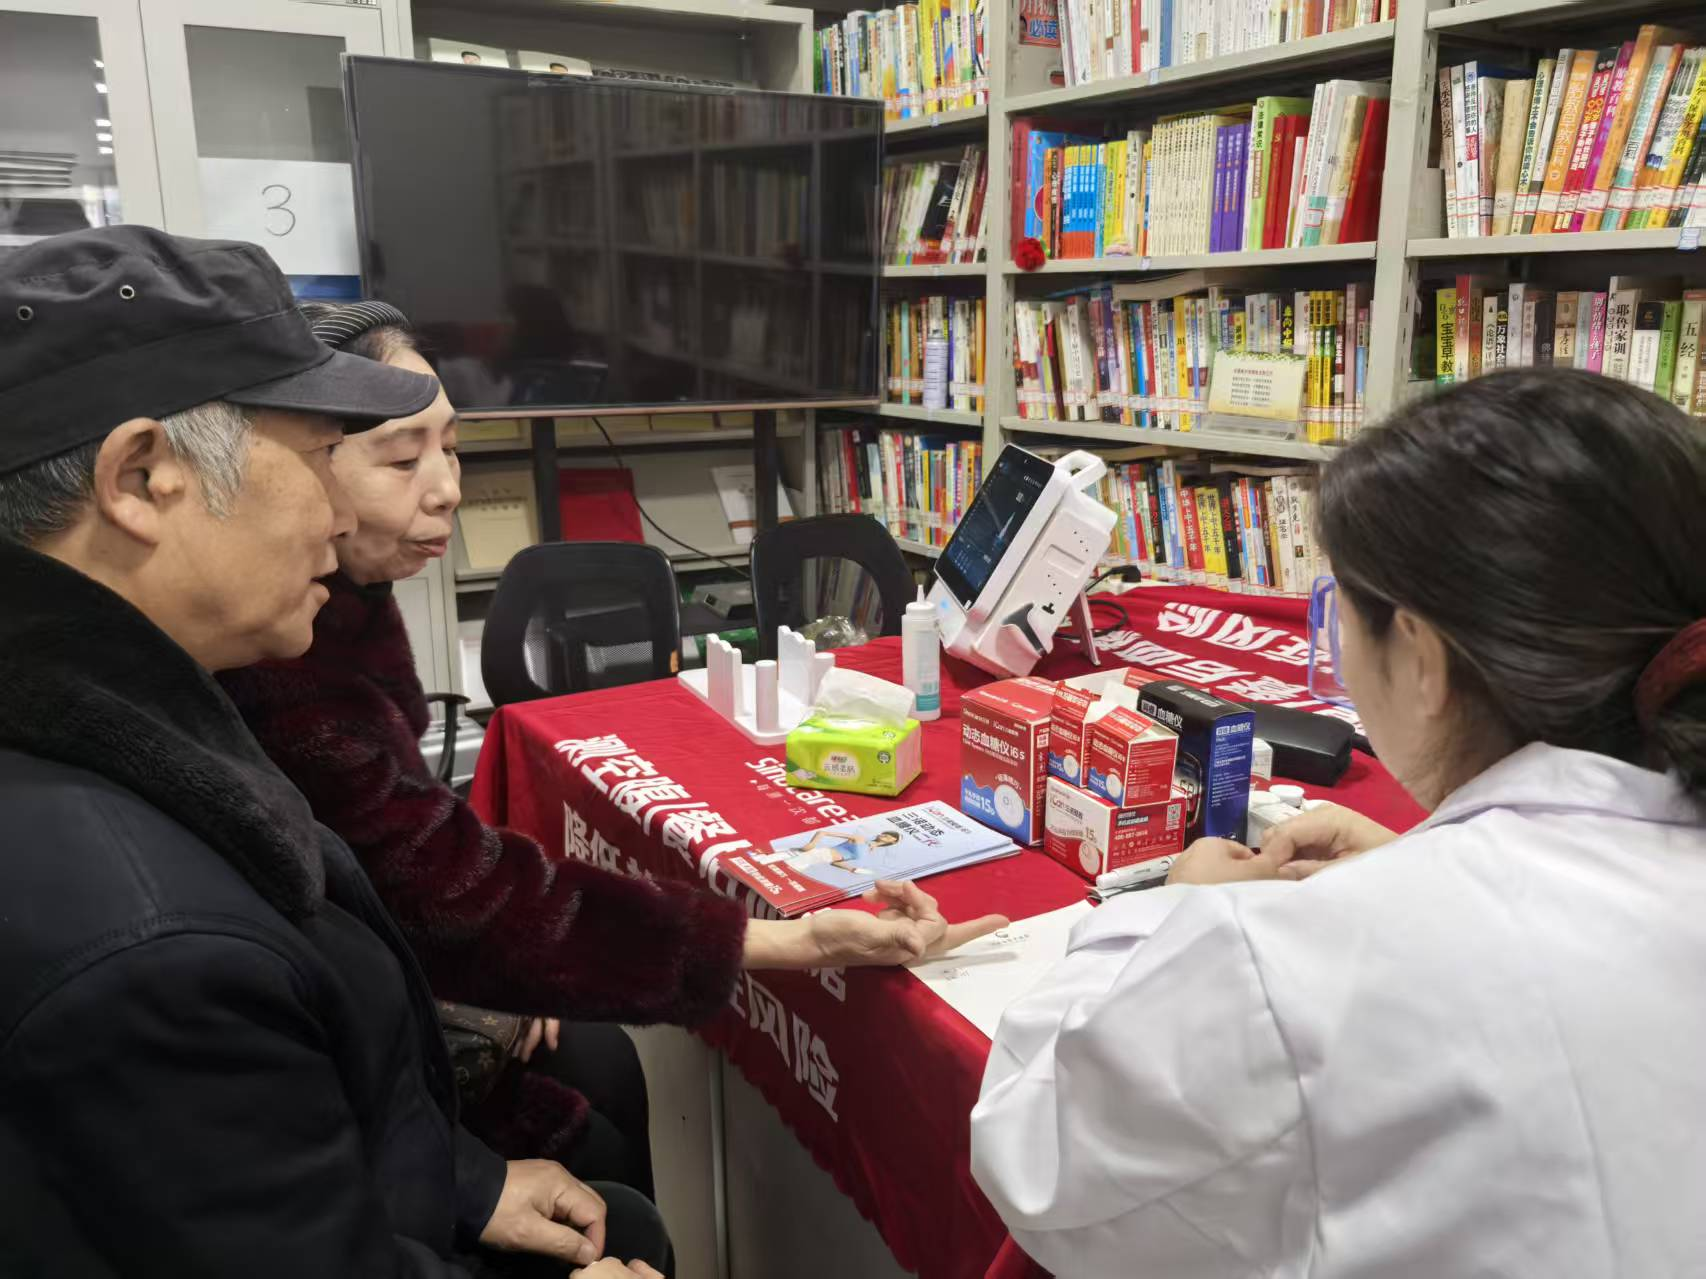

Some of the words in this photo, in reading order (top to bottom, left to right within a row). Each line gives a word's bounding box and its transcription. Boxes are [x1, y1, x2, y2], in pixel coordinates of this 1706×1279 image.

[262, 184, 296, 237] 3
[1440, 321, 1455, 373] 宝宝早教
[1613, 303, 1630, 356] 耶鲁家训
[1680, 320, 1699, 359] 五经
